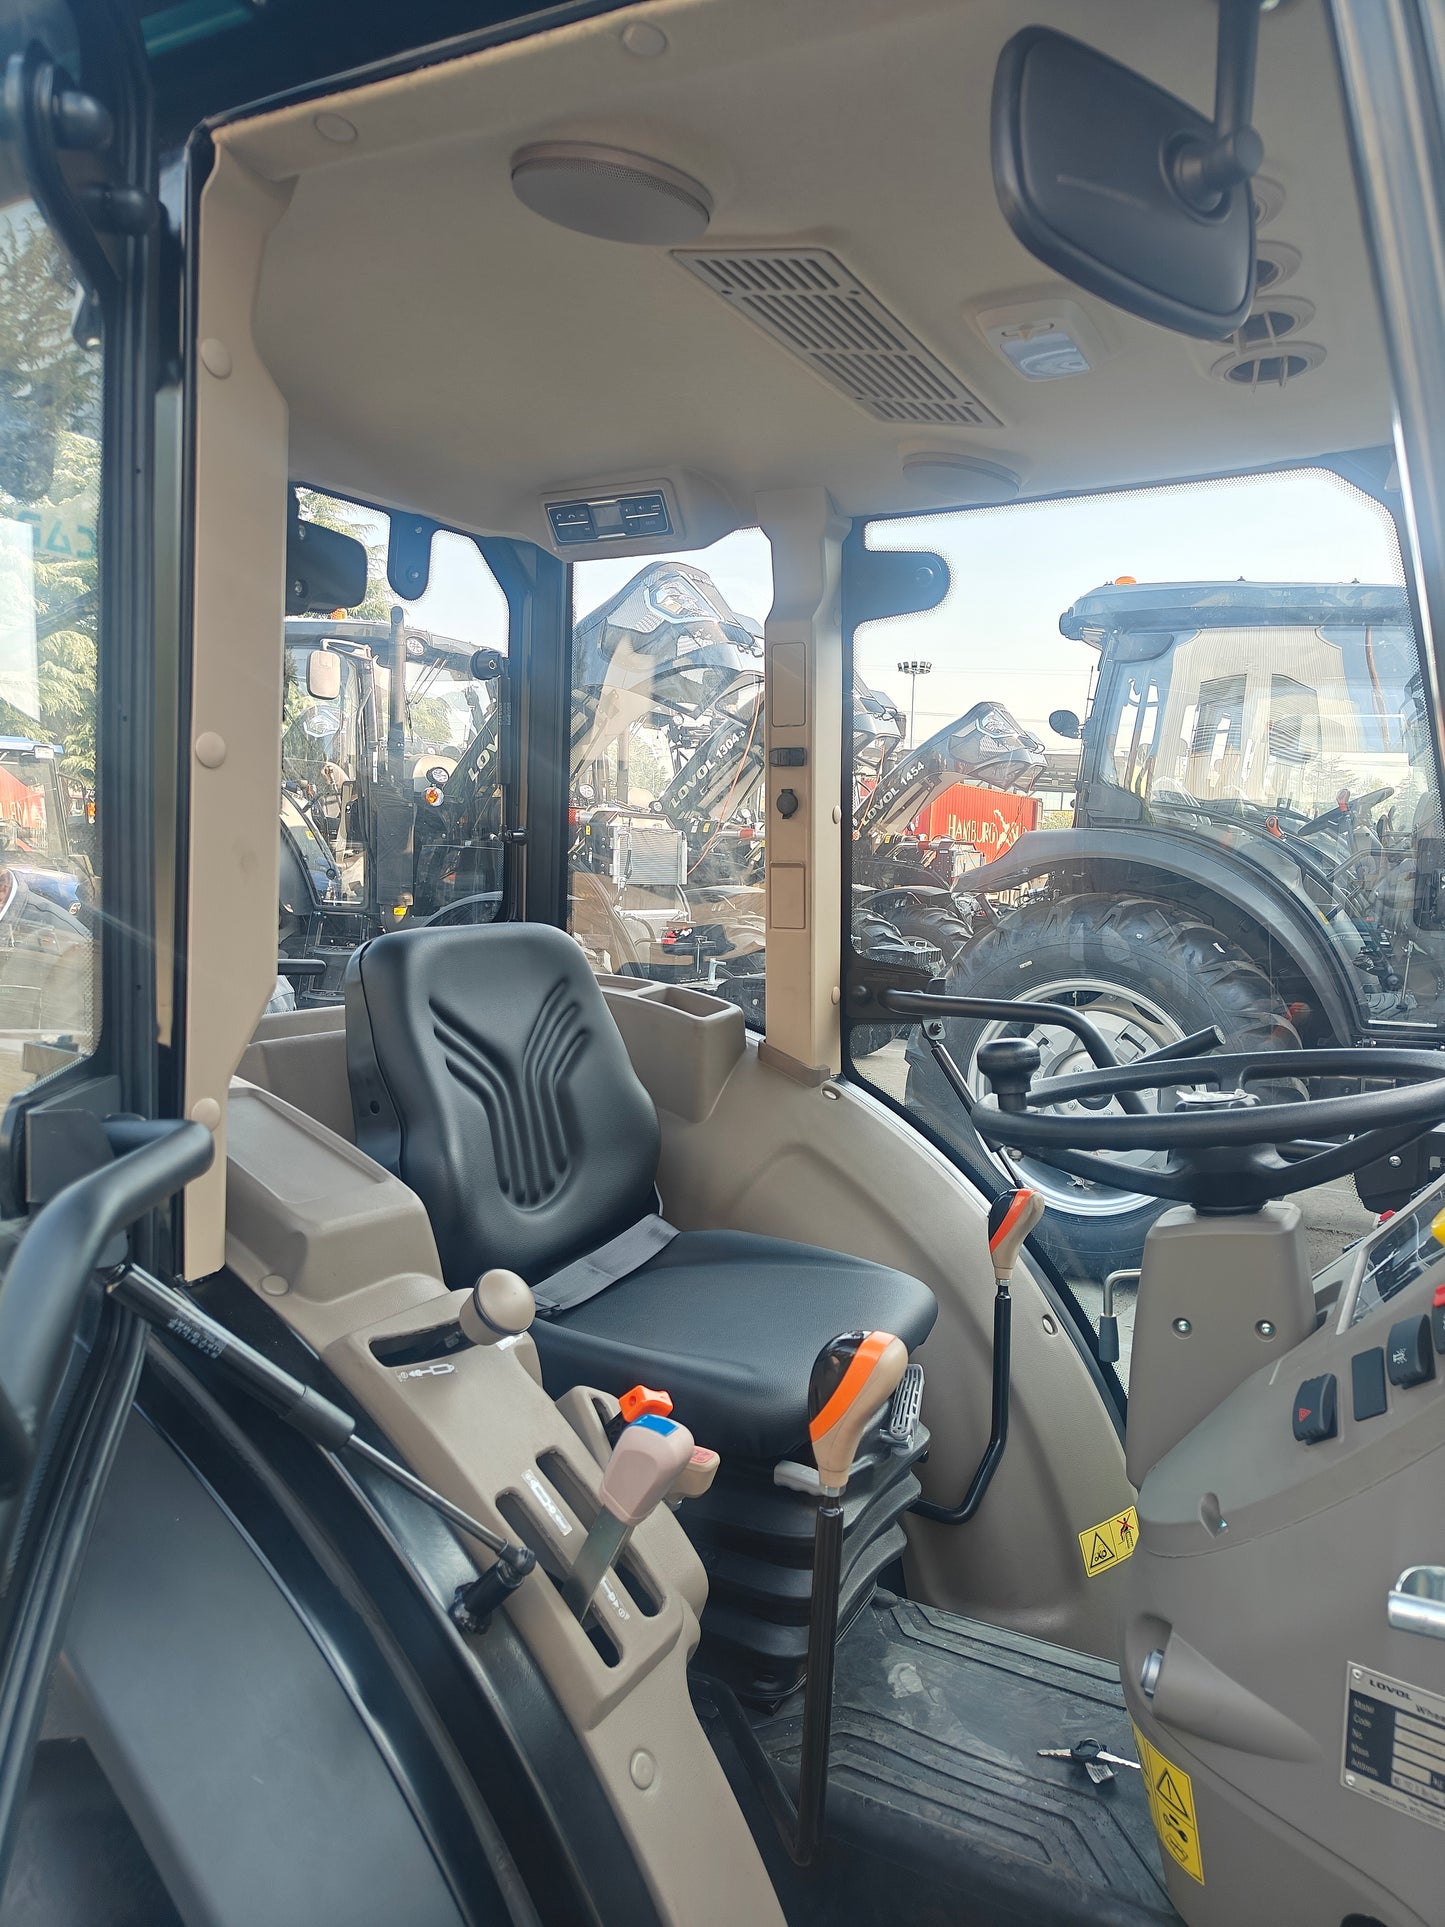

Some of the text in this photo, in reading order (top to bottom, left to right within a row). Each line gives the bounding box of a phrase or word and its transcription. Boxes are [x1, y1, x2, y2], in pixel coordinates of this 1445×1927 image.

[670, 759, 717, 809] LOVOL
[900, 761, 925, 786] 1454
[948, 813, 998, 844] HAMBURG
[1369, 1679, 1412, 1701] LOVOL
